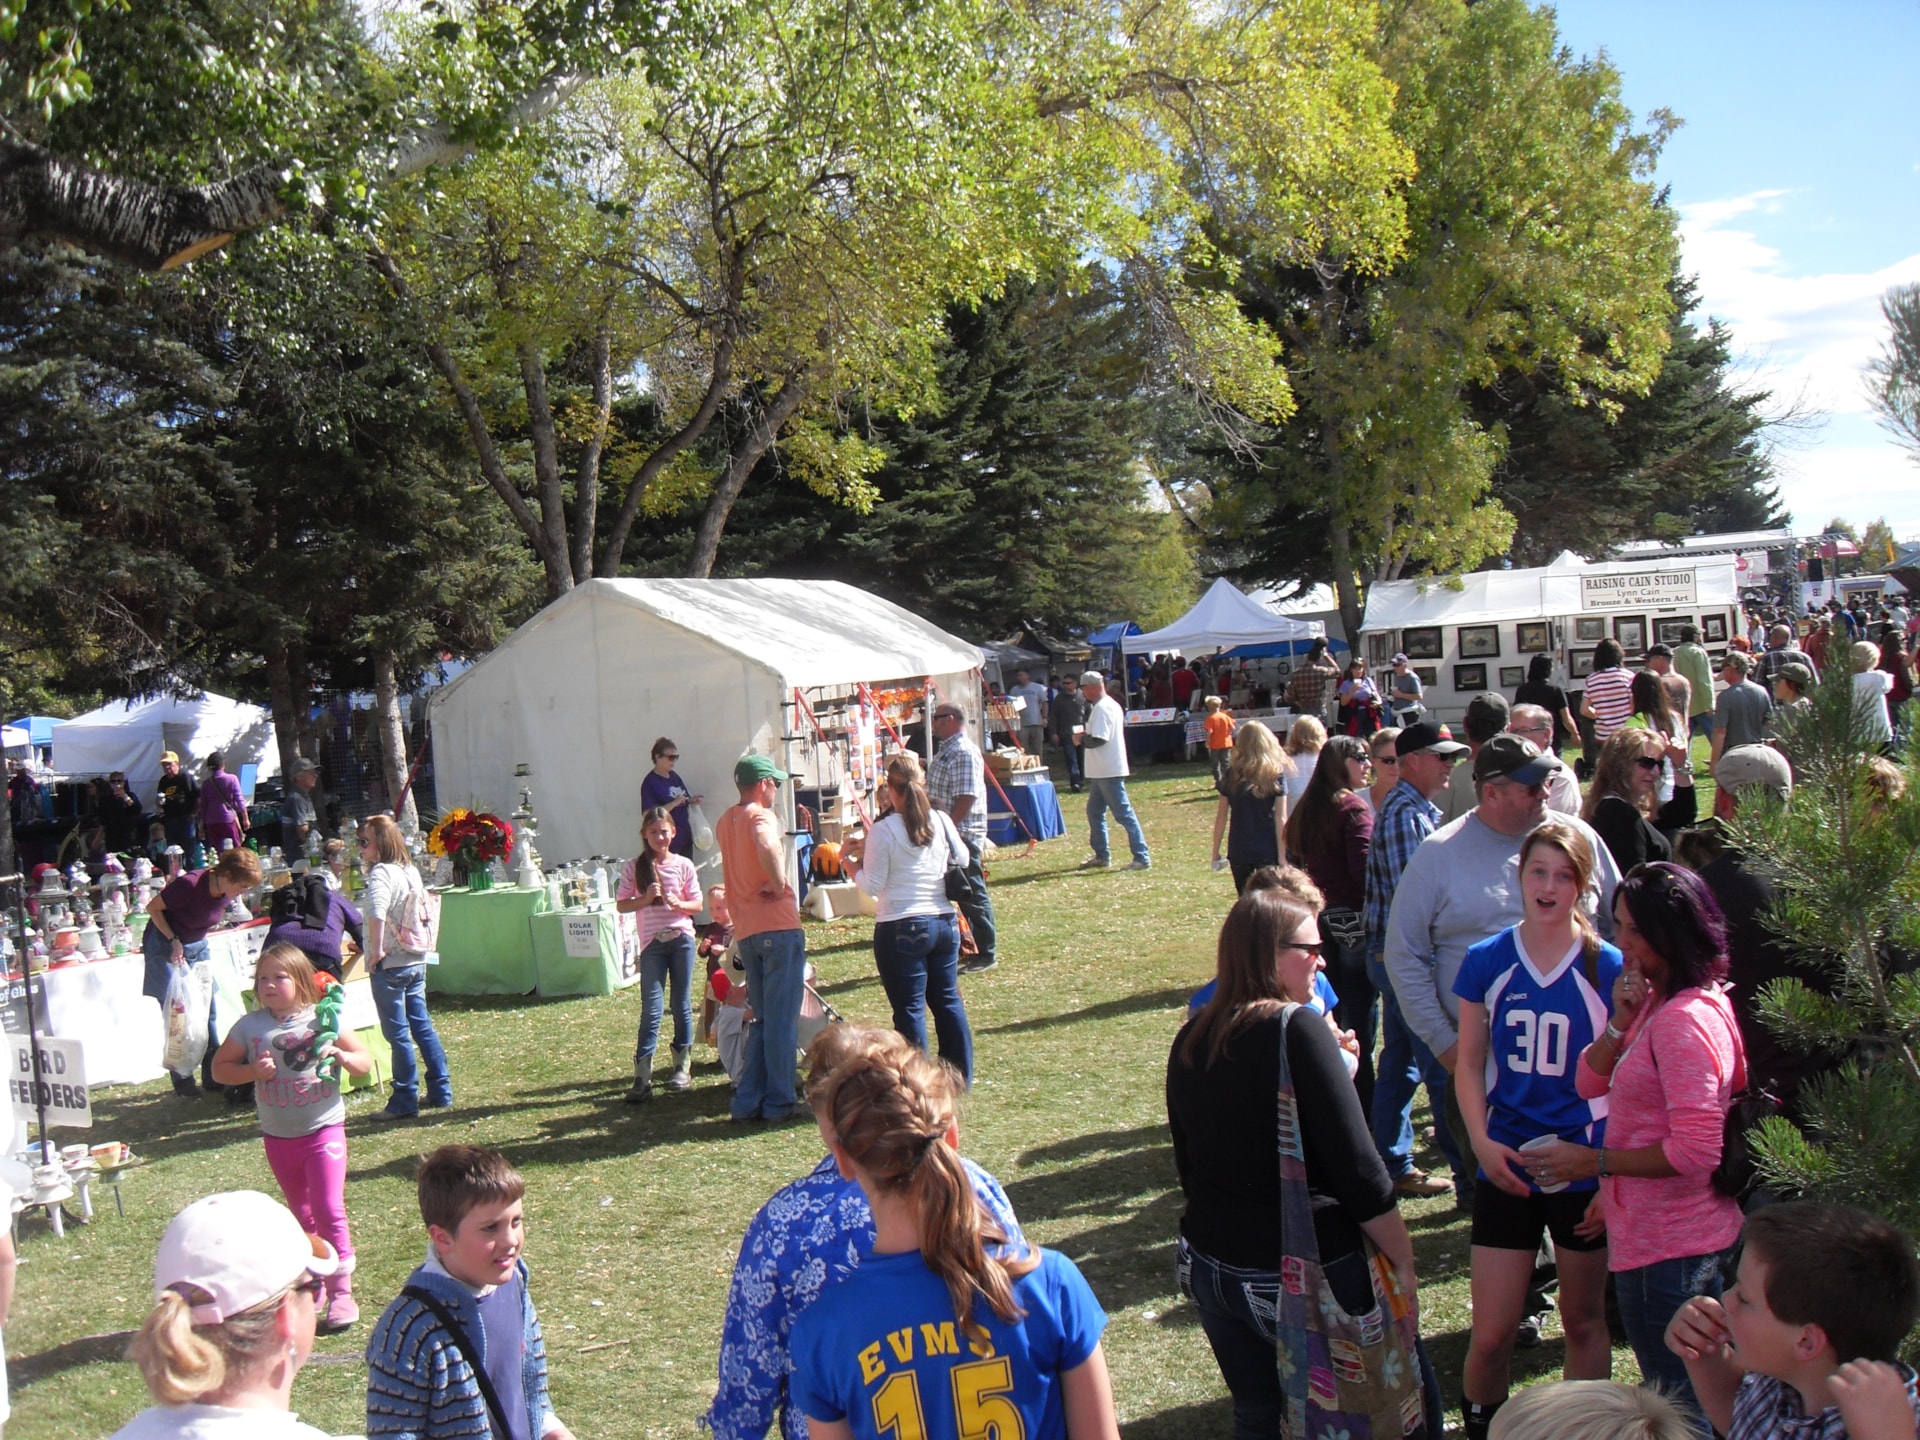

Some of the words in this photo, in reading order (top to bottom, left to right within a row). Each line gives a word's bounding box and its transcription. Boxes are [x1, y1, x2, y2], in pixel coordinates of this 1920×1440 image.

[1585, 577, 1625, 590] RAISING
[1628, 576, 1651, 588] CAIN
[1654, 573, 1691, 586] STUDIO
[1590, 599, 1621, 607] Bronze
[1624, 597, 1632, 605] &
[1634, 596, 1671, 604] Western
[1617, 589, 1638, 598] Lynn
[1640, 588, 1660, 596] Cain
[11, 984, 39, 999] Gls
[1505, 1009, 1570, 1077] 30
[18, 1048, 67, 1074] BRD
[257, 1076, 332, 1109] MUSIC
[871, 1355, 1027, 1440] 15
